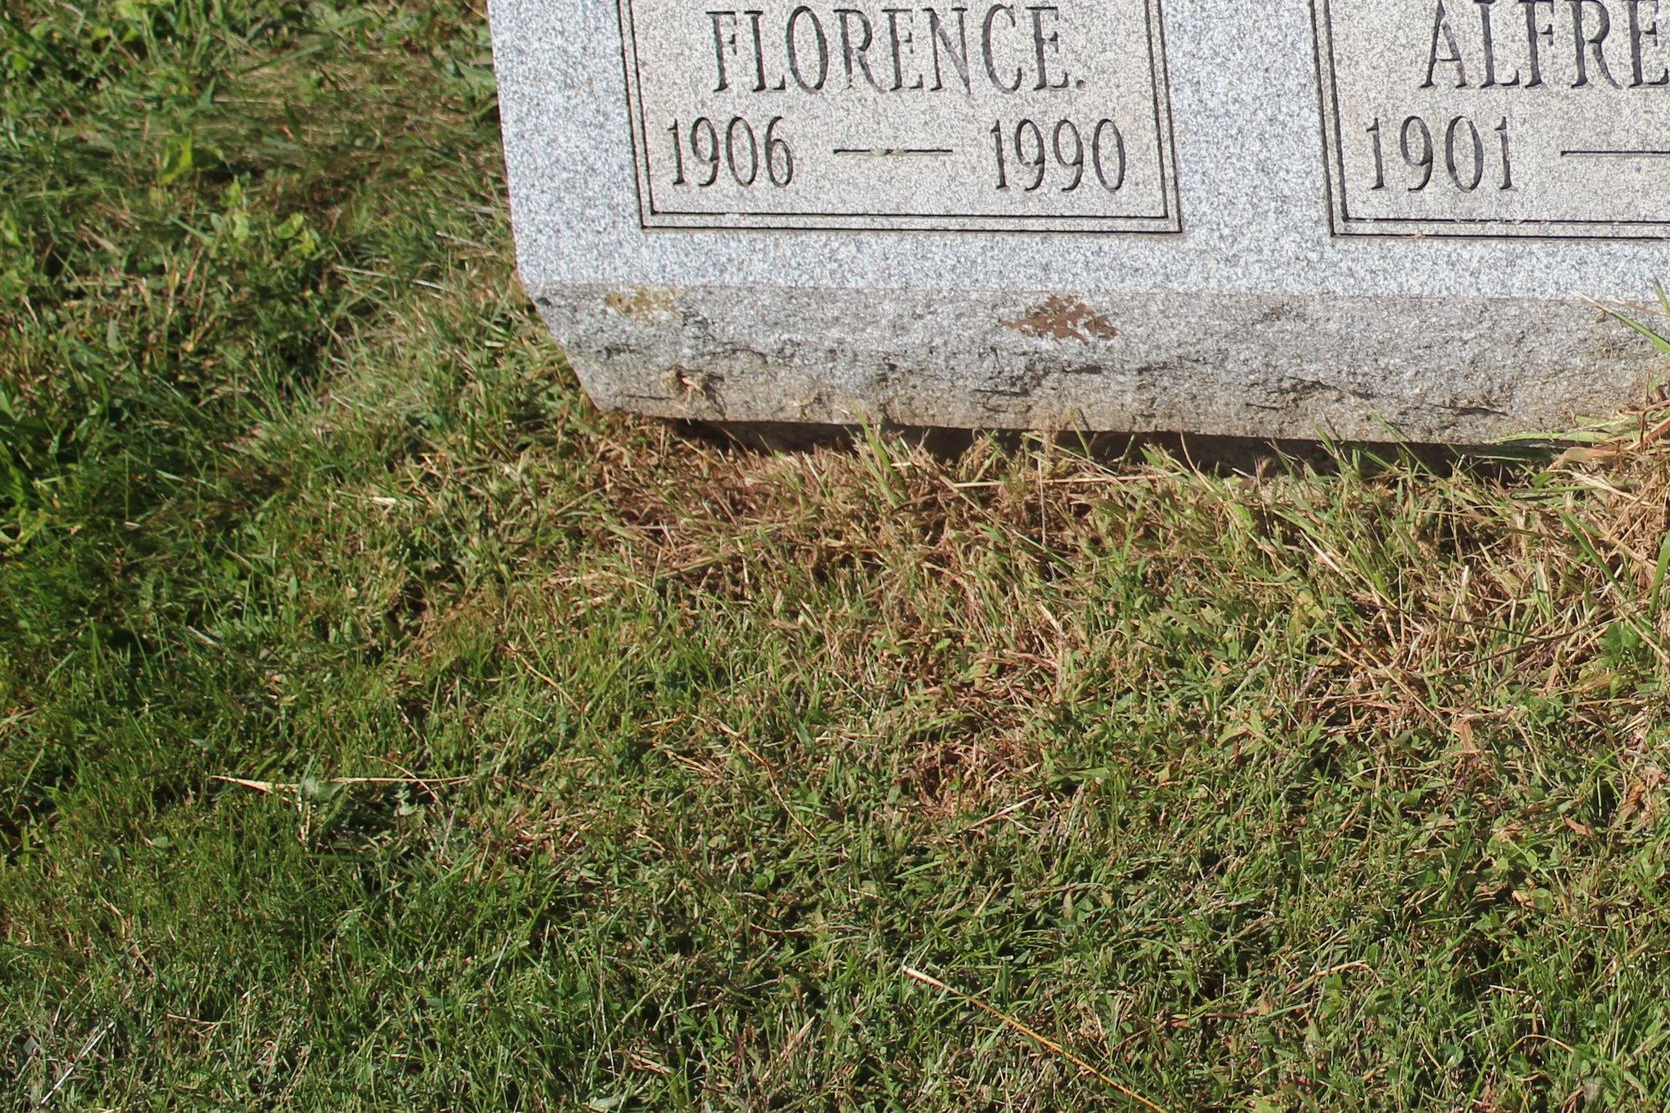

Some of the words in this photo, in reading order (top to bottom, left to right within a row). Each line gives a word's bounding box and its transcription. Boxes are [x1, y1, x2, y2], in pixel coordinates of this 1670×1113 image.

[668, 116, 794, 188] 1906
[990, 118, 1126, 192] 1990
[1366, 115, 1513, 192] 1901
